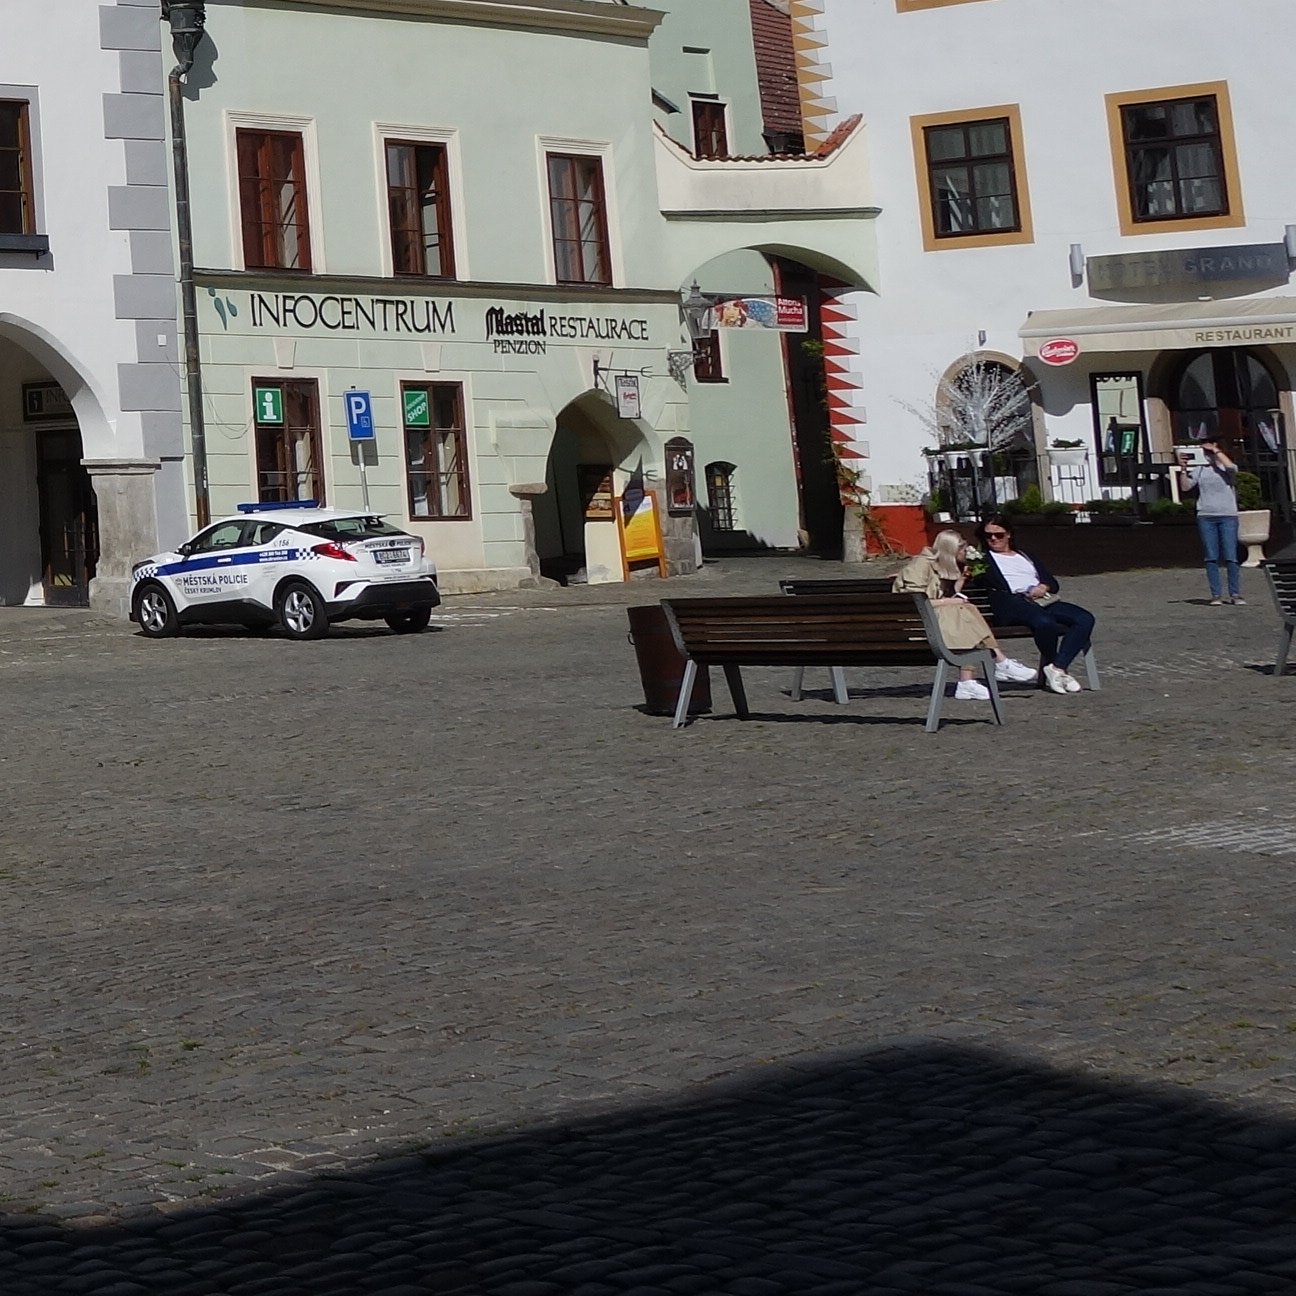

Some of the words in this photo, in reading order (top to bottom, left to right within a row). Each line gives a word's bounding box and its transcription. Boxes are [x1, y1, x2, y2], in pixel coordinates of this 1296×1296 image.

[250, 293, 456, 334] INFOCENTRUM
[778, 306, 803, 314] Mucha
[550, 316, 649, 341] RESTAURACE
[1195, 327, 1294, 342] RESTAURANT
[493, 339, 546, 355] PENZION
[350, 397, 366, 425] P
[407, 401, 427, 422] SHOP
[183, 572, 217, 586] MĚSTSKÁ
[219, 574, 248, 585] POLICIE
